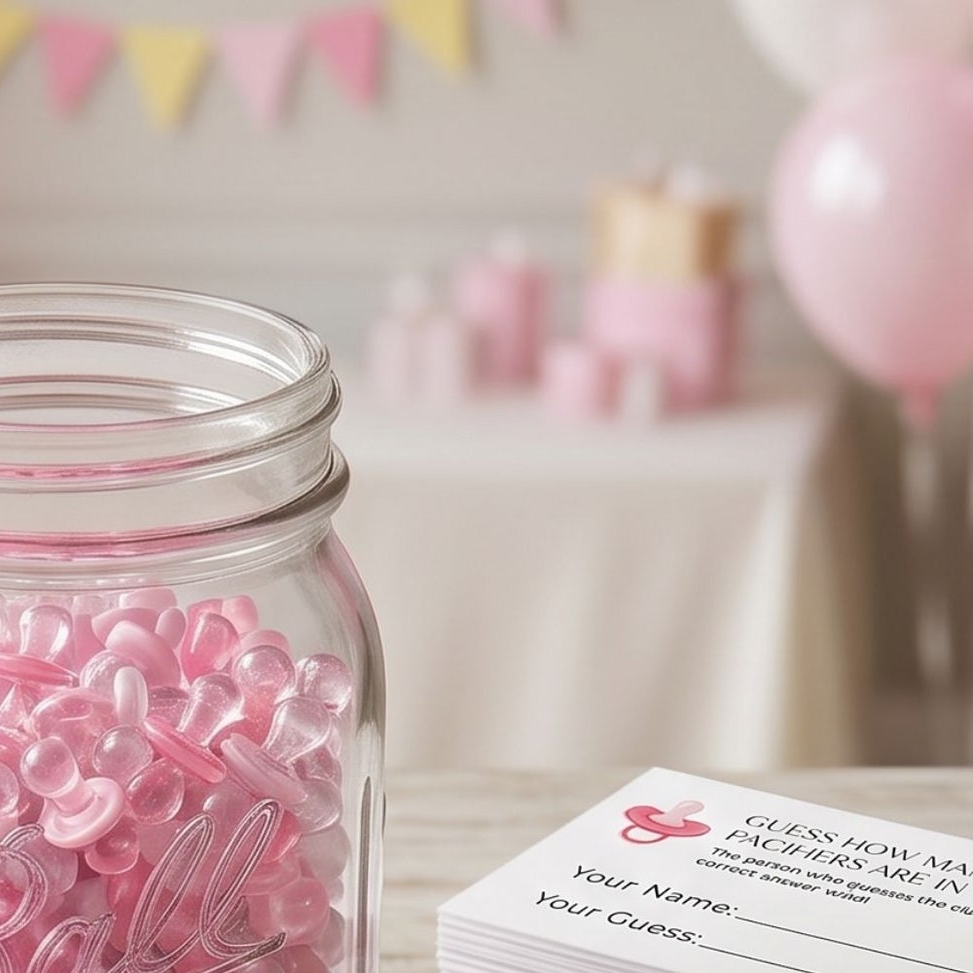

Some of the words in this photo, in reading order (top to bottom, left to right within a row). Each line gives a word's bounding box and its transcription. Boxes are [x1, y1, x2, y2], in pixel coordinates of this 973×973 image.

[746, 815, 838, 844] GUESS
[841, 837, 921, 861] HOW
[573, 865, 638, 890] Your
[643, 884, 738, 916] Name:
[807, 872, 844, 884] who
[918, 897, 947, 908] the
[867, 865, 931, 886] ARE
[934, 878, 968, 894] IN
[536, 891, 602, 917] Your
[607, 912, 702, 944] Guess:
